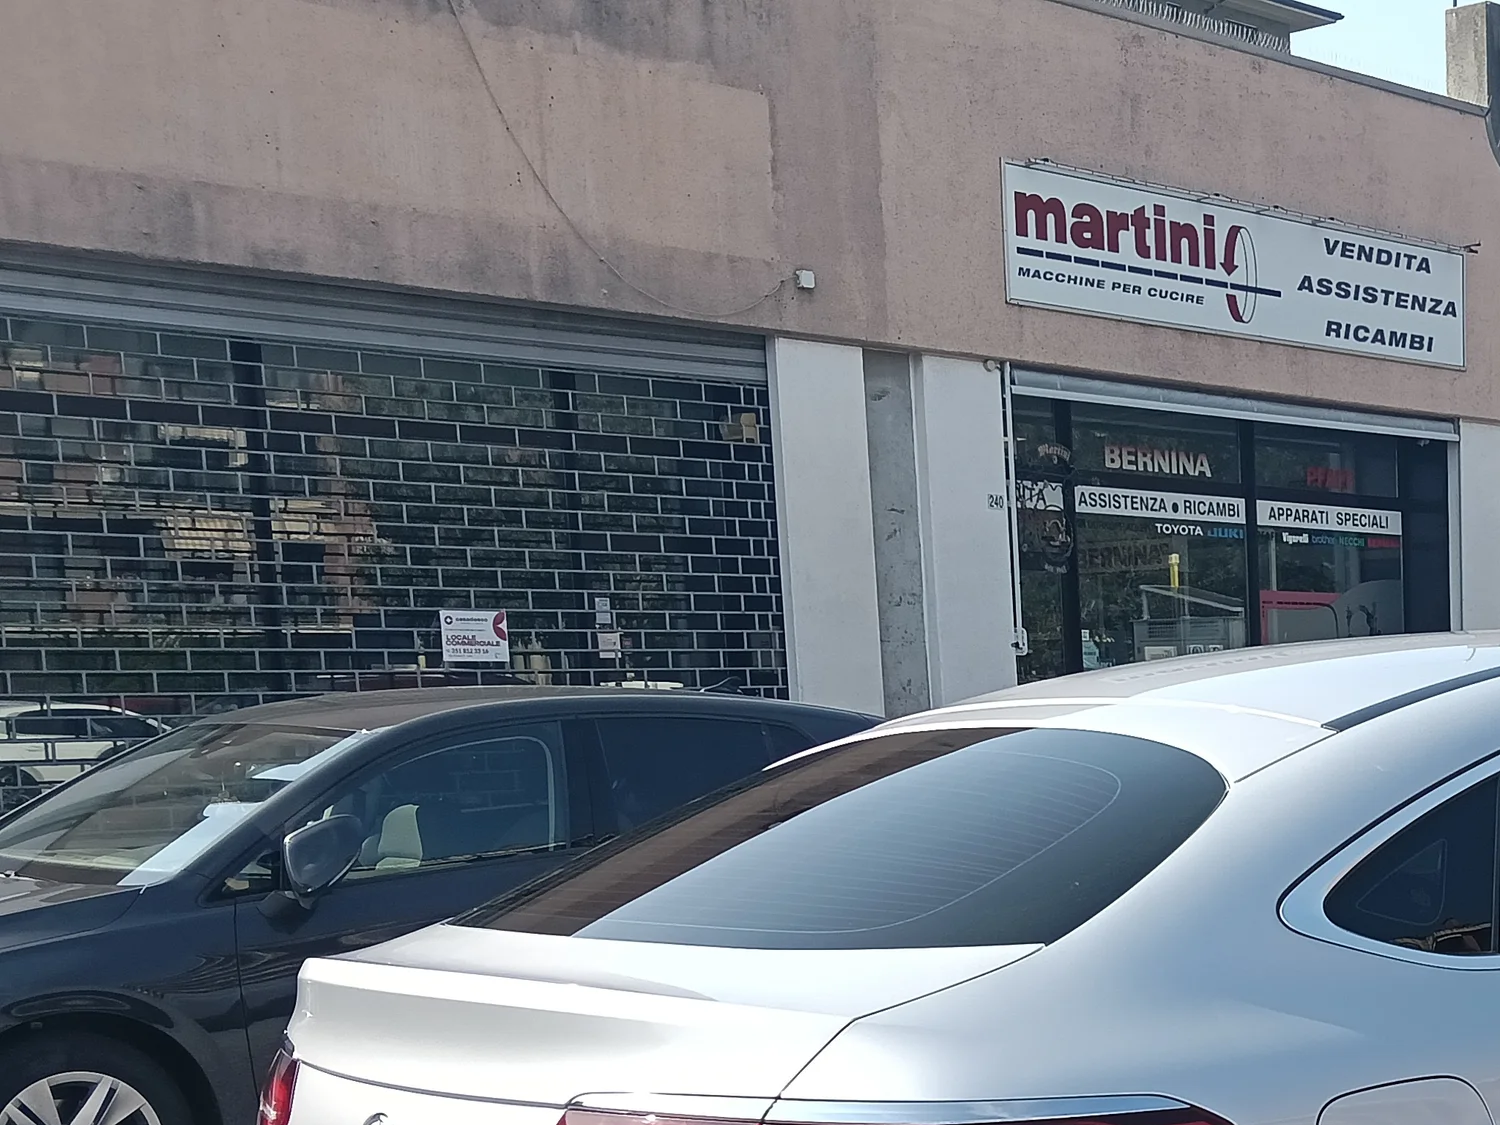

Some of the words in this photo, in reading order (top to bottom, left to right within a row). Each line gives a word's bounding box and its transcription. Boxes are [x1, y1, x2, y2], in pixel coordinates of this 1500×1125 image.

[1014, 191, 1216, 270] martini
[1323, 238, 1431, 274] VENDITA
[1017, 267, 1106, 289] MACCHINE
[1111, 281, 1142, 295] PER
[1147, 288, 1205, 305] CUCIRE
[1297, 275, 1457, 318] ASSISTENZA
[1325, 320, 1433, 352] RICAMBI
[1104, 446, 1212, 477] BERNINA
[1078, 492, 1167, 513] ASSISTENZA
[1184, 500, 1240, 517] RICAMBI
[1268, 506, 1329, 524] APPARATI
[1336, 511, 1389, 529] SPECIALI
[1155, 523, 1204, 536] TOYOTA
[1207, 527, 1244, 539] JUKI
[1339, 535, 1365, 547] NECCHI
